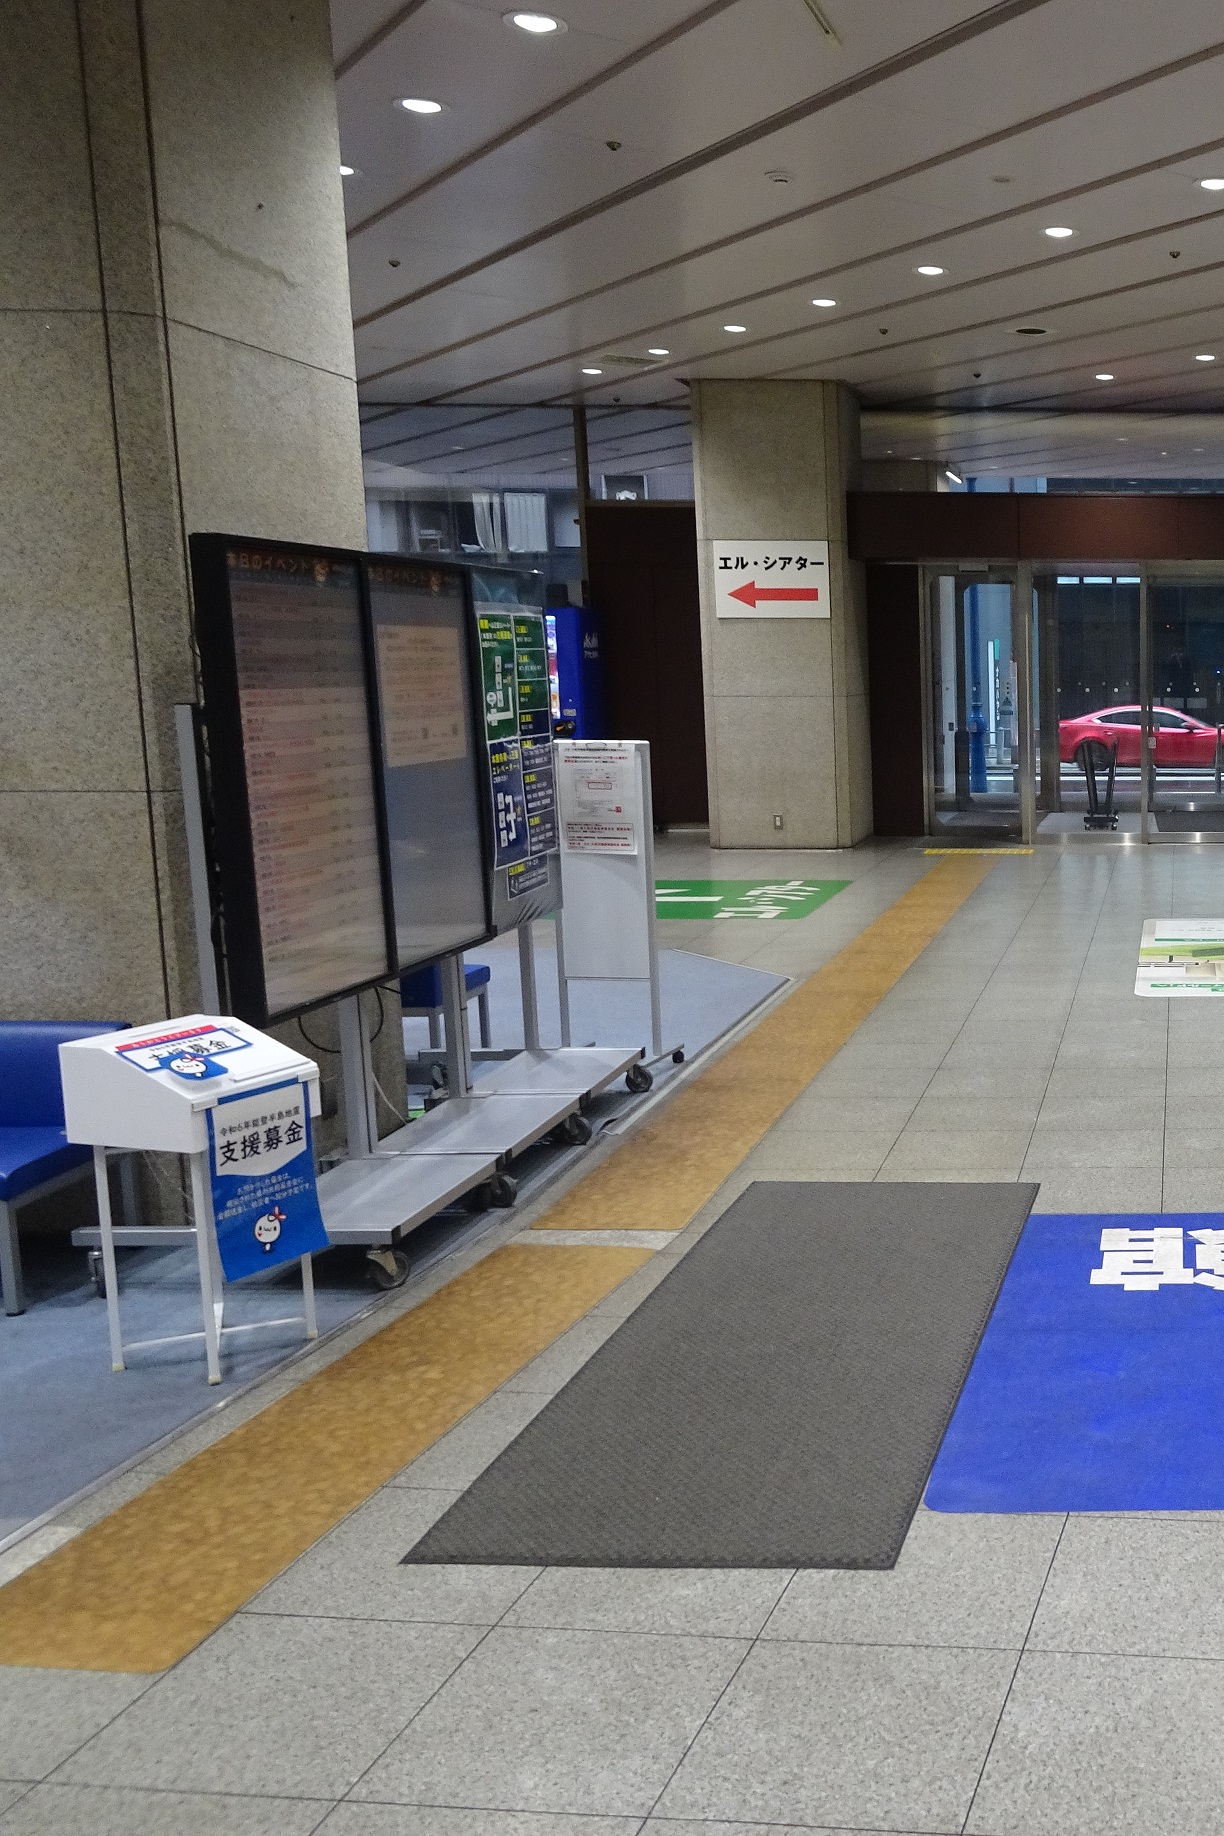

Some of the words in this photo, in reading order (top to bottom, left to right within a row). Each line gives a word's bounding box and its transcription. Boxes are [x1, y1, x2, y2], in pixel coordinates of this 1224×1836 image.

[718, 556, 824, 571] エル・シアター
[219, 1120, 303, 1166] 支援募金
